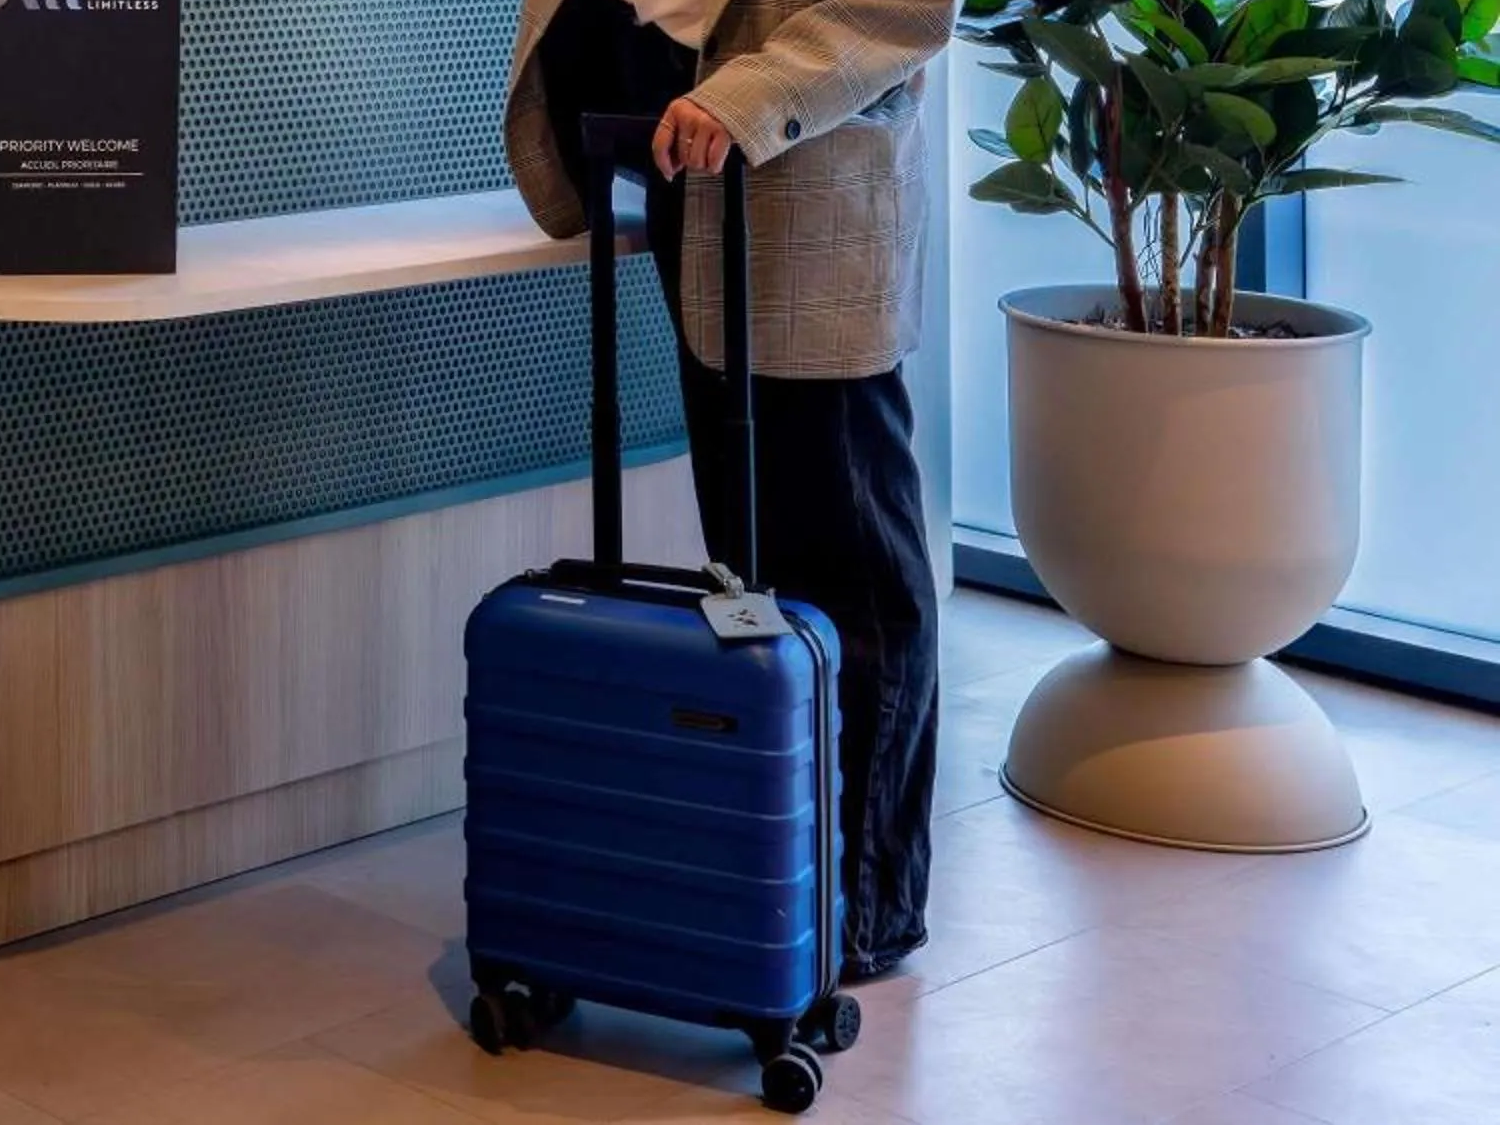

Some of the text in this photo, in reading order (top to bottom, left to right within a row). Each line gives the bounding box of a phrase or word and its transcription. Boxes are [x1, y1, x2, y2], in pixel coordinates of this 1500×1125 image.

[87, 0, 159, 10] LIMITLESS
[0, 138, 139, 152] PRIORITY WELCOME
[20, 160, 60, 170] ACCUEIL
